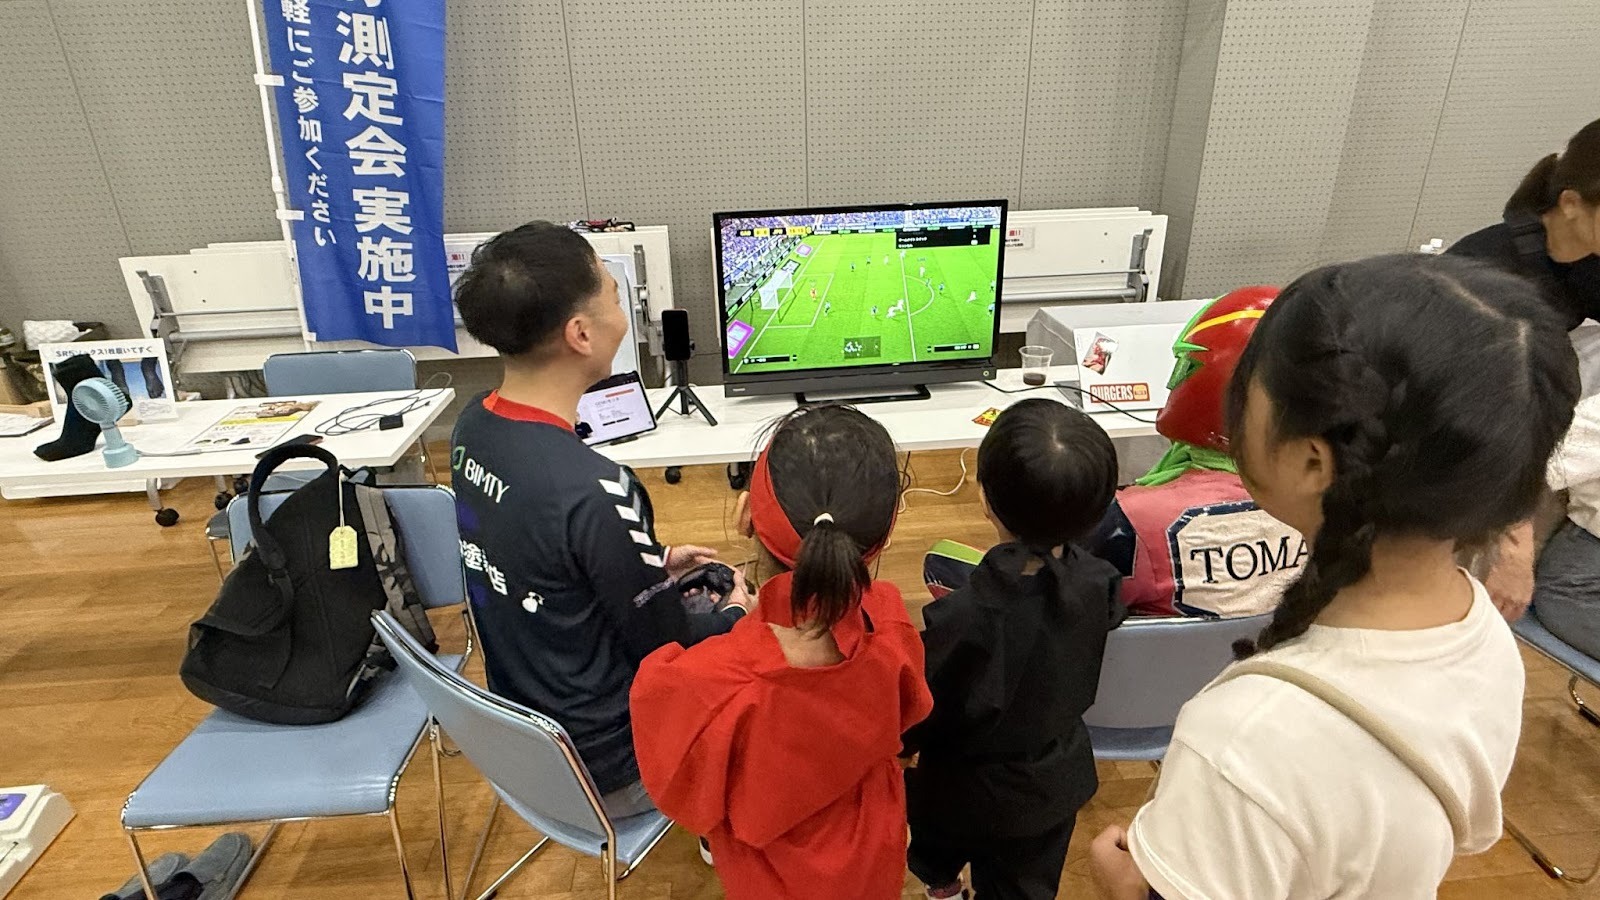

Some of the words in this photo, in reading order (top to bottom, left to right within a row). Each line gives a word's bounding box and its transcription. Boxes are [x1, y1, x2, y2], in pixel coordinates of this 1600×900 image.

[336, 0, 416, 329] 測定会実施中
[1091, 384, 1134, 402] BURGERS
[464, 458, 511, 504] BIMTY
